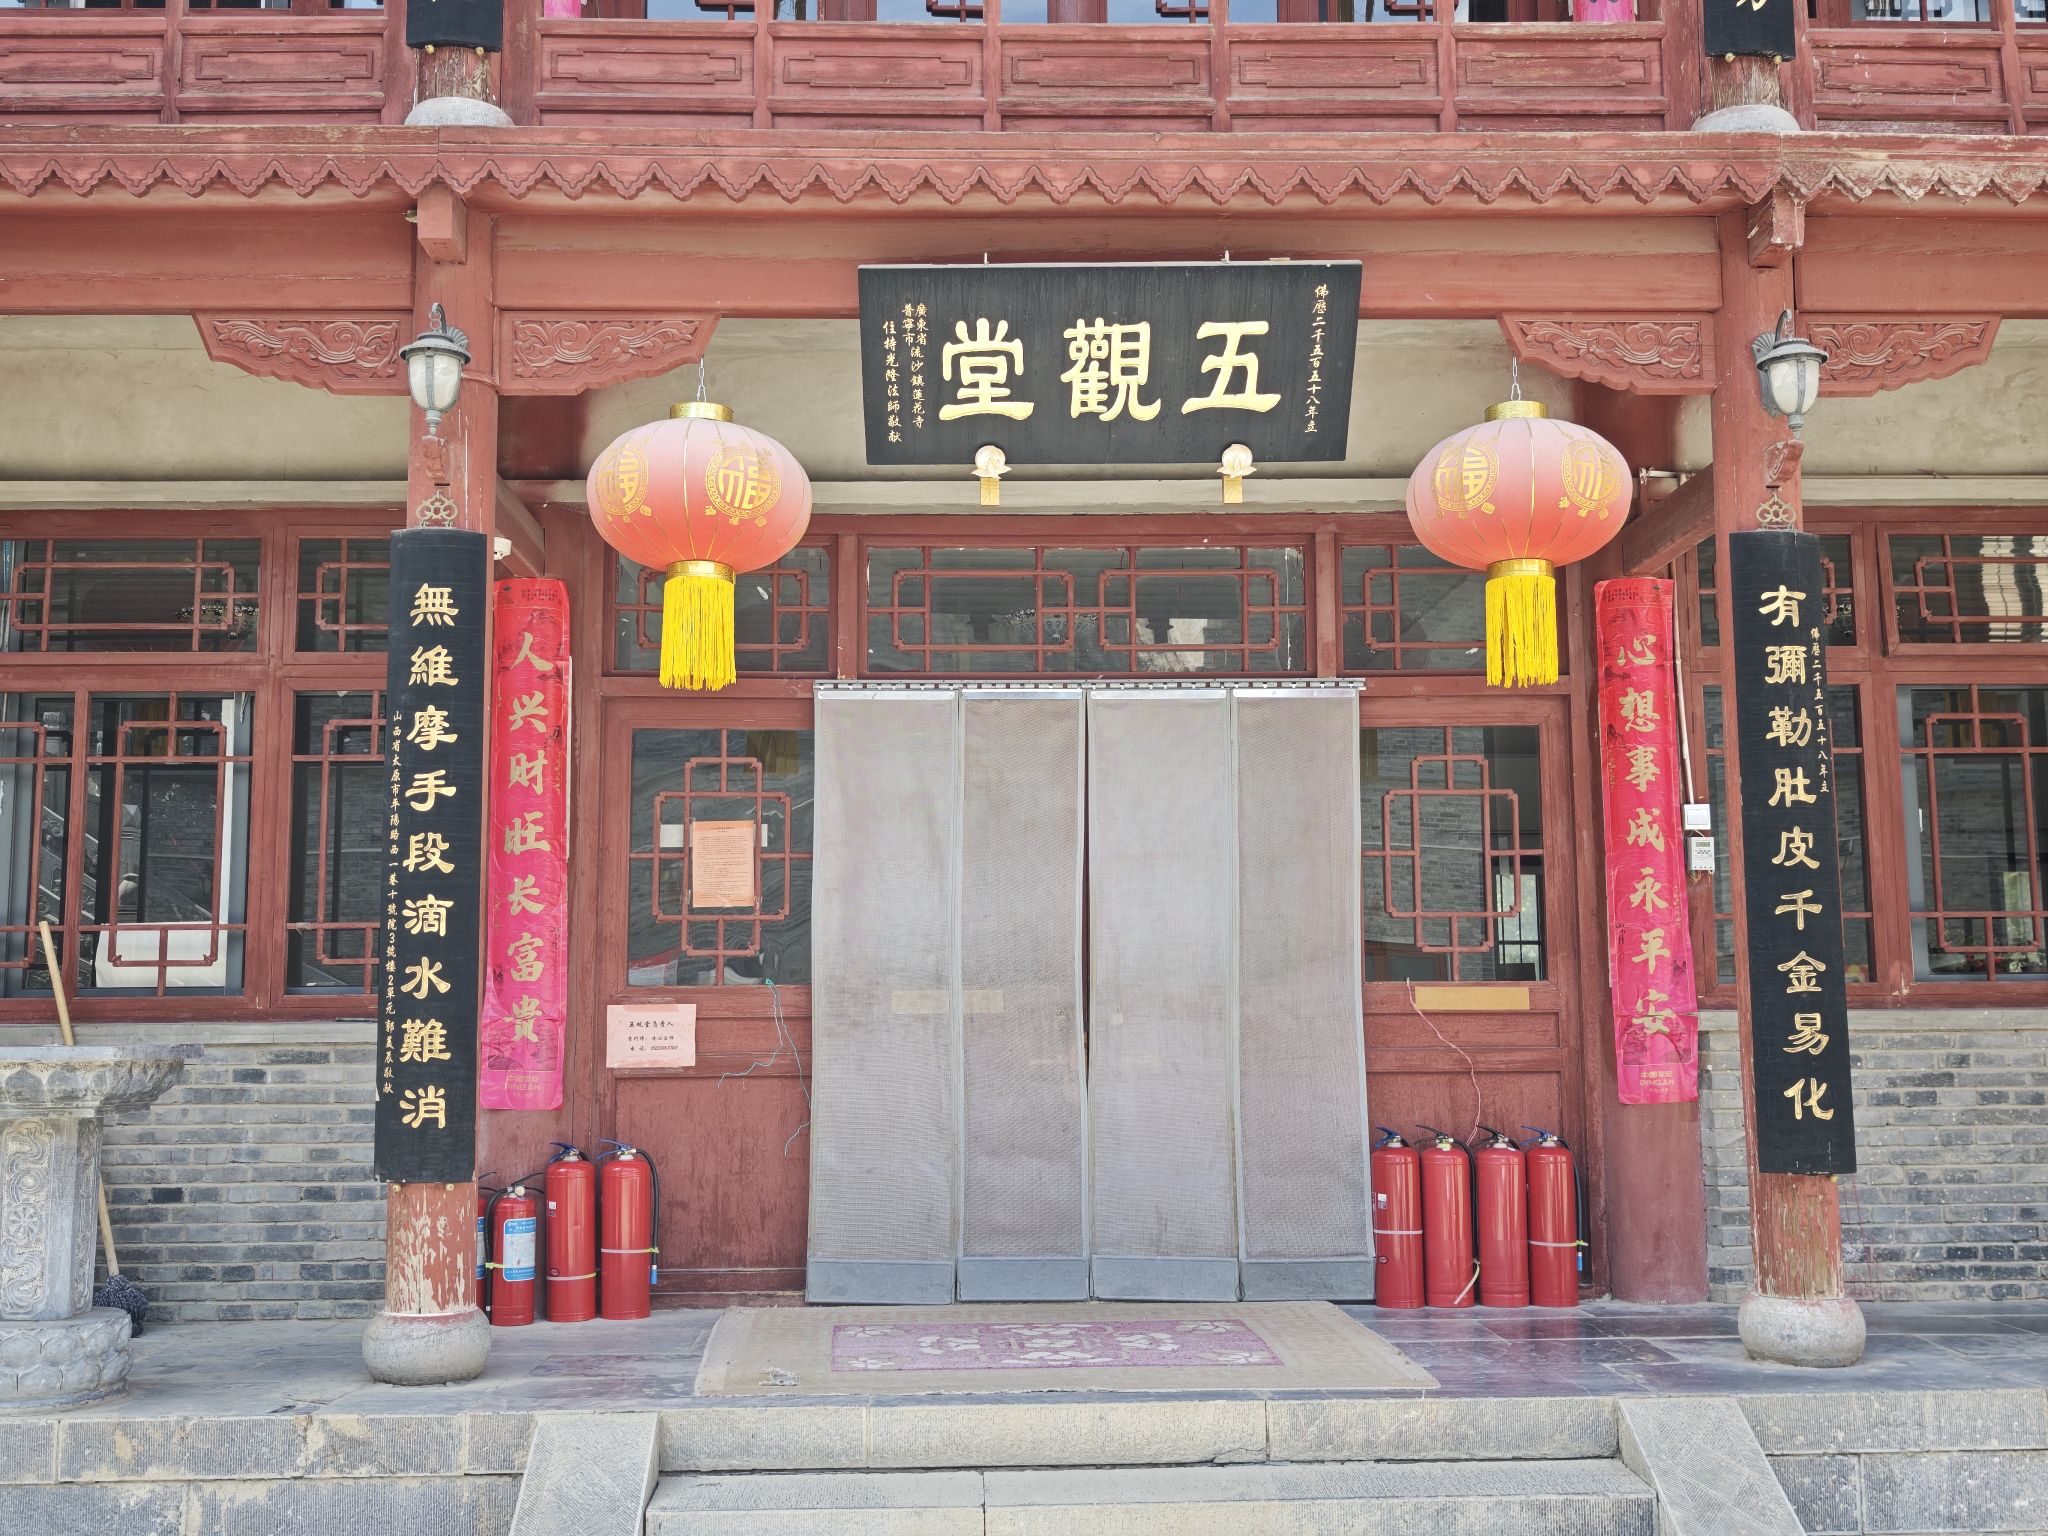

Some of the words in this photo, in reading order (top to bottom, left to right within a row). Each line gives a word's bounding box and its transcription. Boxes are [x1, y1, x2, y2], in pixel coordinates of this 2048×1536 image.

[399, 582, 459, 1129] 無維摩手段滴水難消
[1616, 632, 1677, 1036] 心想事成永平安
[1759, 584, 1834, 1121] 有彌勒肚皮千金易化
